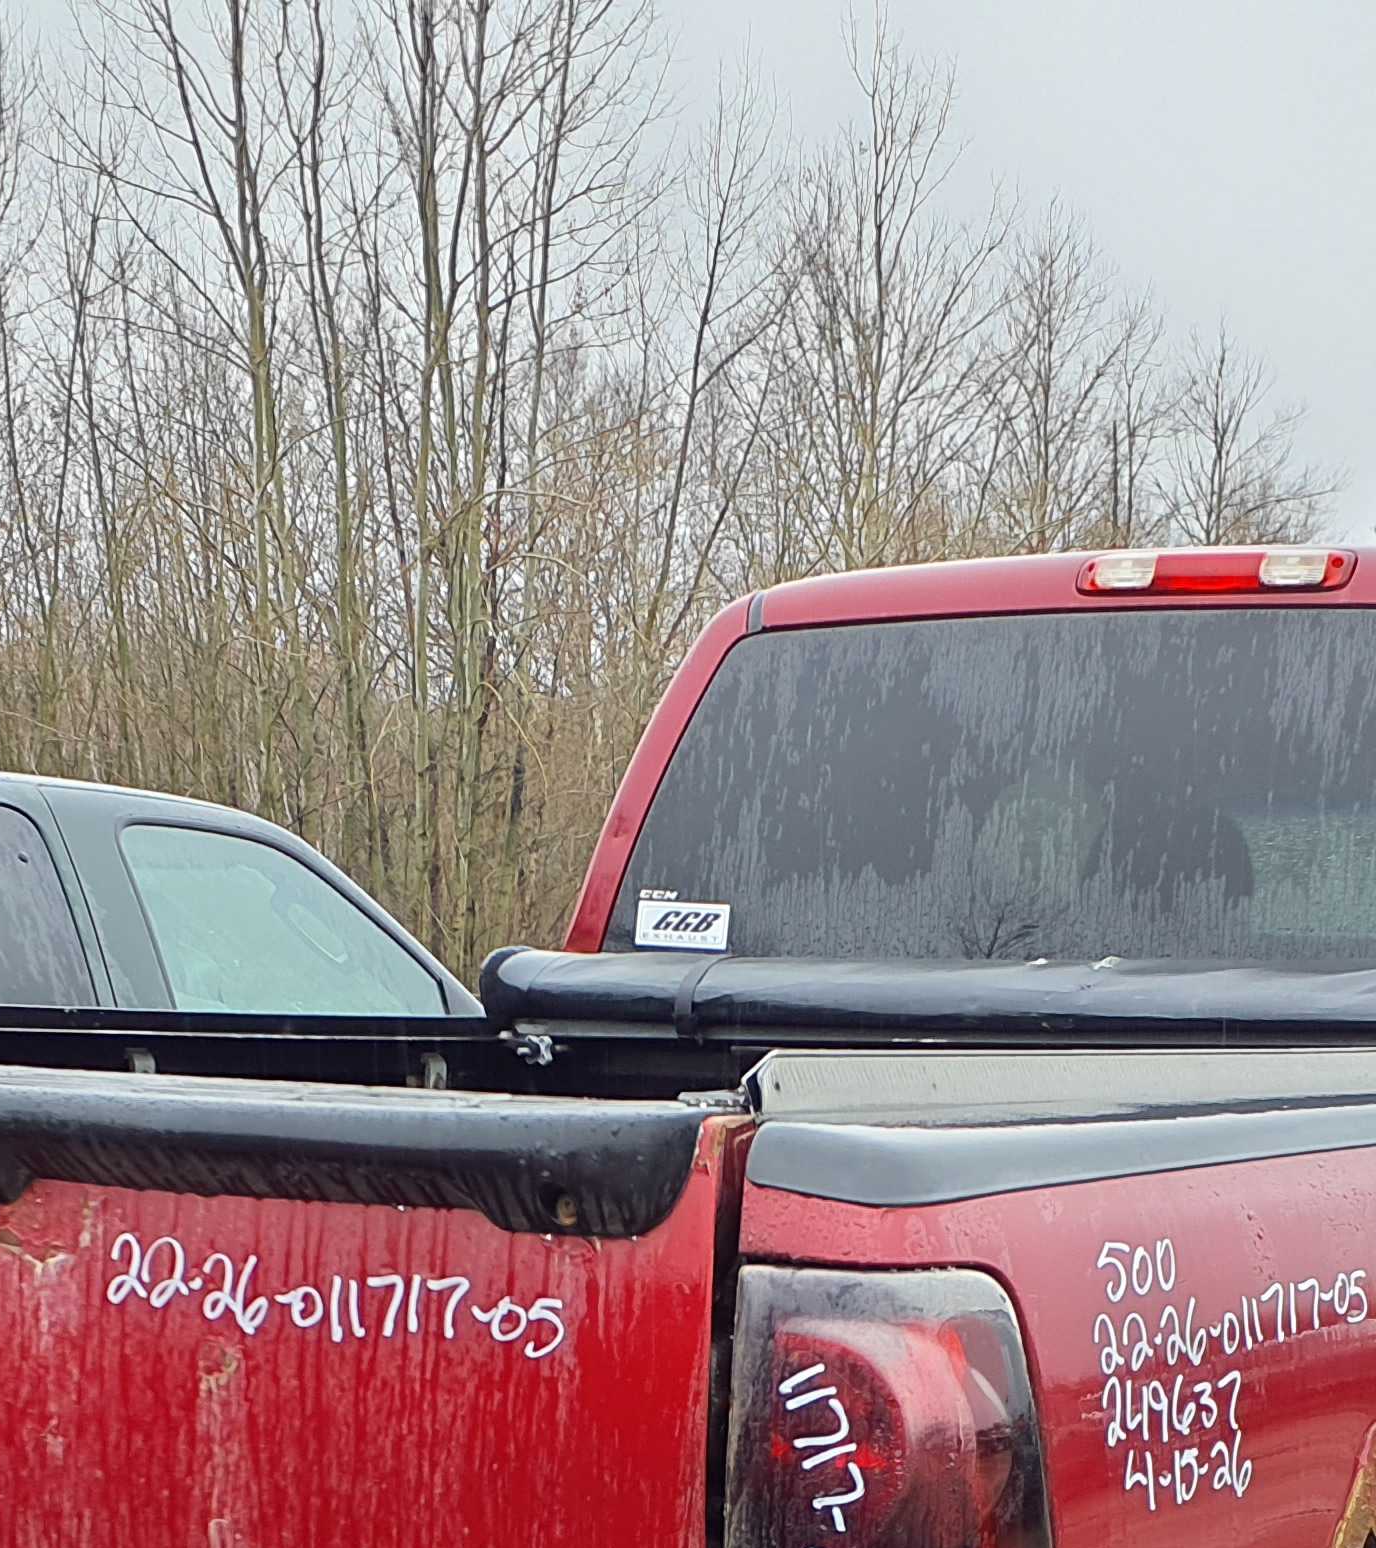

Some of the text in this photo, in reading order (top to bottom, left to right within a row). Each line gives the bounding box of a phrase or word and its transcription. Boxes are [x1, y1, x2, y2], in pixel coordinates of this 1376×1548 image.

[652, 910, 722, 933] GGB
[1096, 1238, 1176, 1303] 500
[1102, 1370, 1242, 1447] 249637
[1124, 1429, 1253, 1511] 4-15-26
